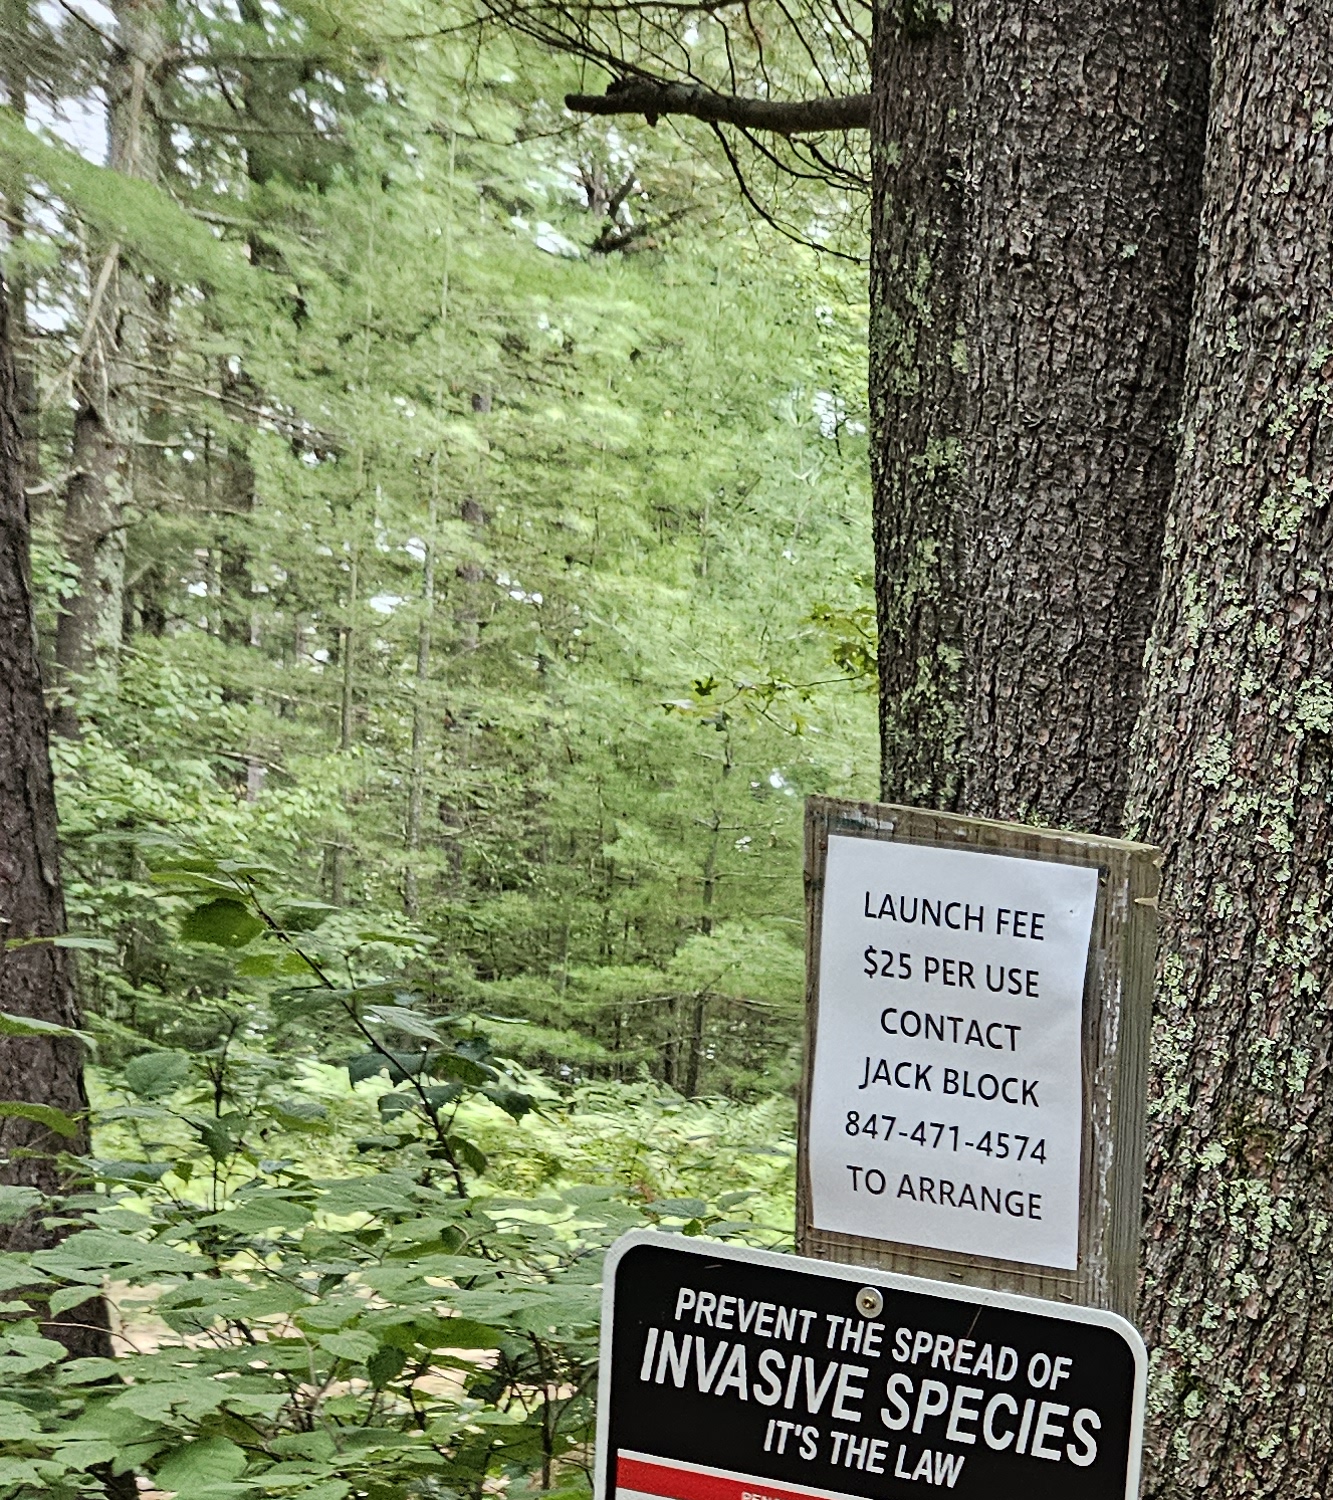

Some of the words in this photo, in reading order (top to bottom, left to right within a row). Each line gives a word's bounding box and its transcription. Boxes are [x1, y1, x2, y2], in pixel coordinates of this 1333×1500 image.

[863, 891, 984, 933] LAUNCH
[996, 909, 1045, 941] FEE
[863, 945, 912, 979] $25
[924, 957, 976, 989] PER
[987, 964, 1039, 998] USE
[880, 1007, 1021, 1052] CONTACT
[858, 1056, 932, 1092] JACK
[943, 1067, 1039, 1107] BLOCK
[844, 1110, 1047, 1164] 847-471-4574
[846, 1166, 886, 1195] TO
[897, 1174, 1042, 1220] ARRANGE
[674, 1288, 817, 1344] PREVENT
[826, 1314, 885, 1358] THE
[892, 1327, 1018, 1382] SPREAD
[1027, 1352, 1073, 1391] OF
[640, 1328, 869, 1423] INVASIVE
[880, 1373, 1102, 1467] SPECIES
[764, 1419, 819, 1461] IT'S
[831, 1431, 887, 1474] THE
[894, 1444, 965, 1489] LAW
